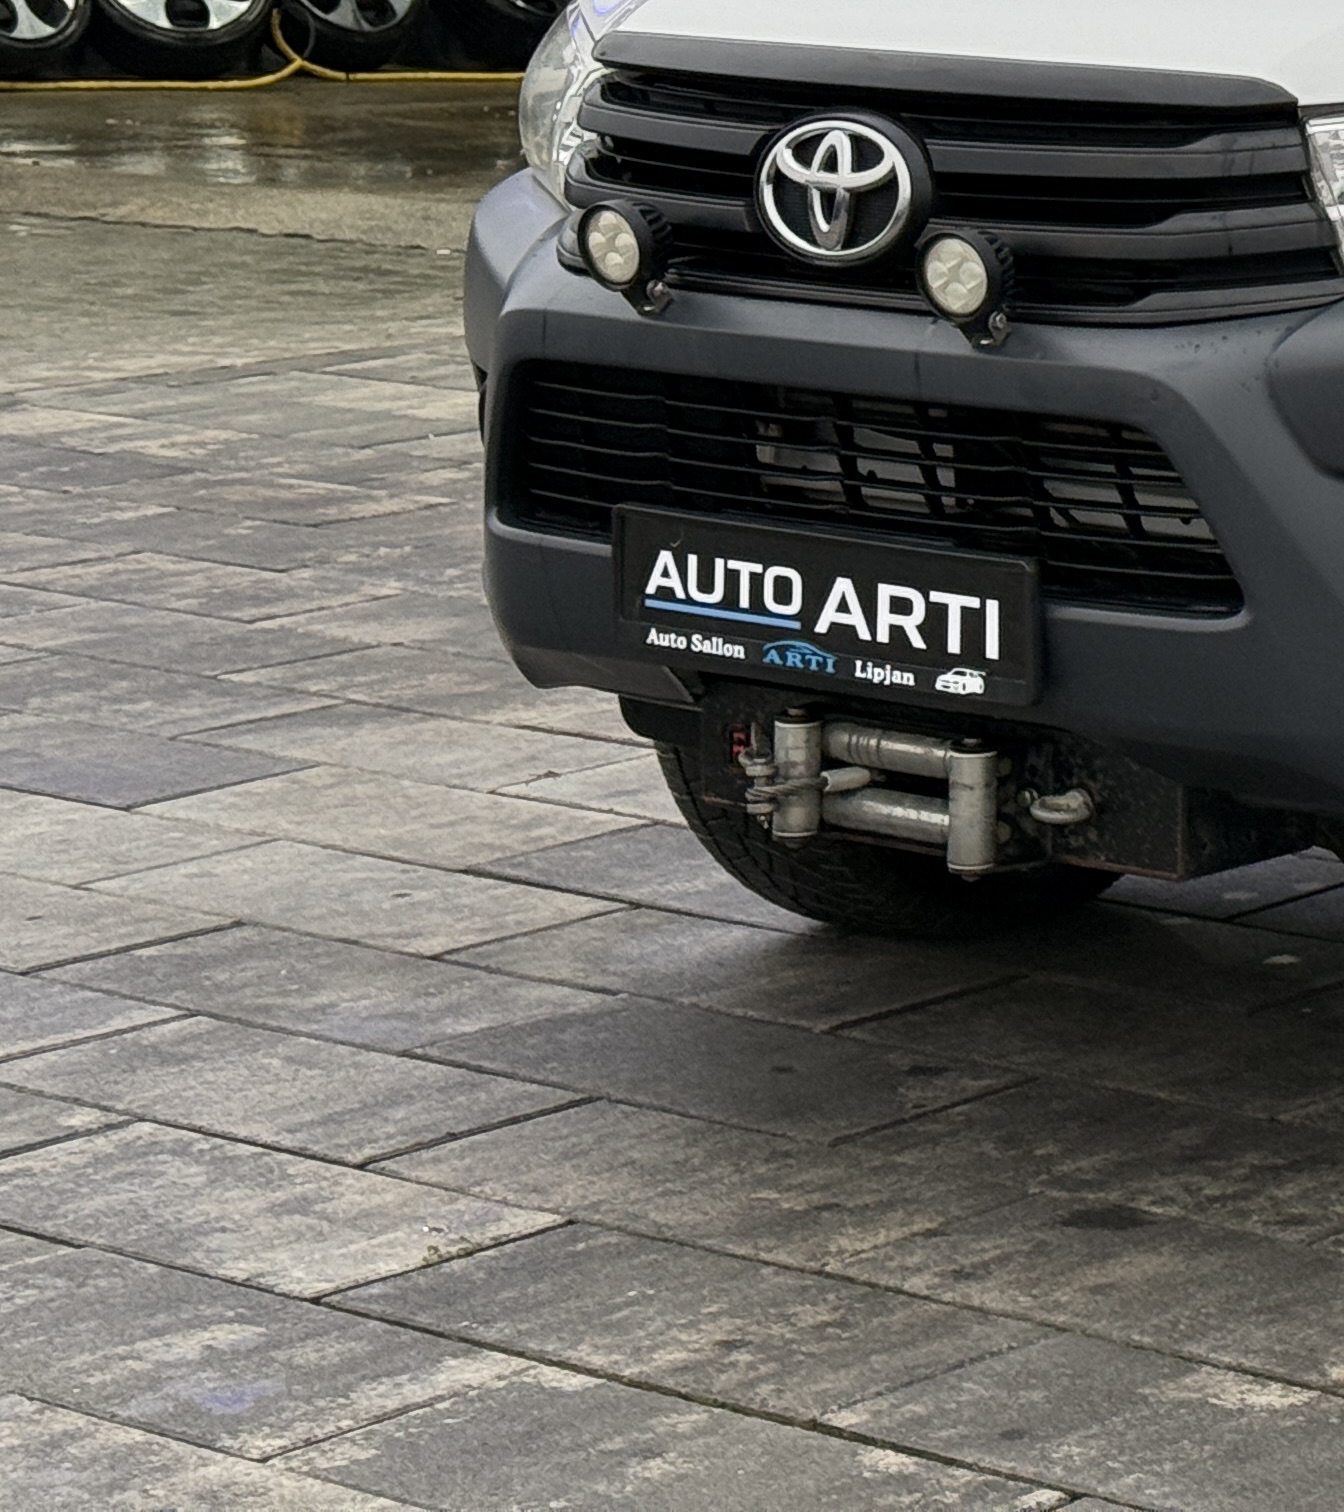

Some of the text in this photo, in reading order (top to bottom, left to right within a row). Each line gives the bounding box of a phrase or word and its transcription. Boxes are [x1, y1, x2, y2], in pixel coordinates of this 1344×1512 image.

[644, 549, 1000, 661] AUTO ARTI
[645, 627, 916, 687] Auto Sallon ARTI Lipjan
